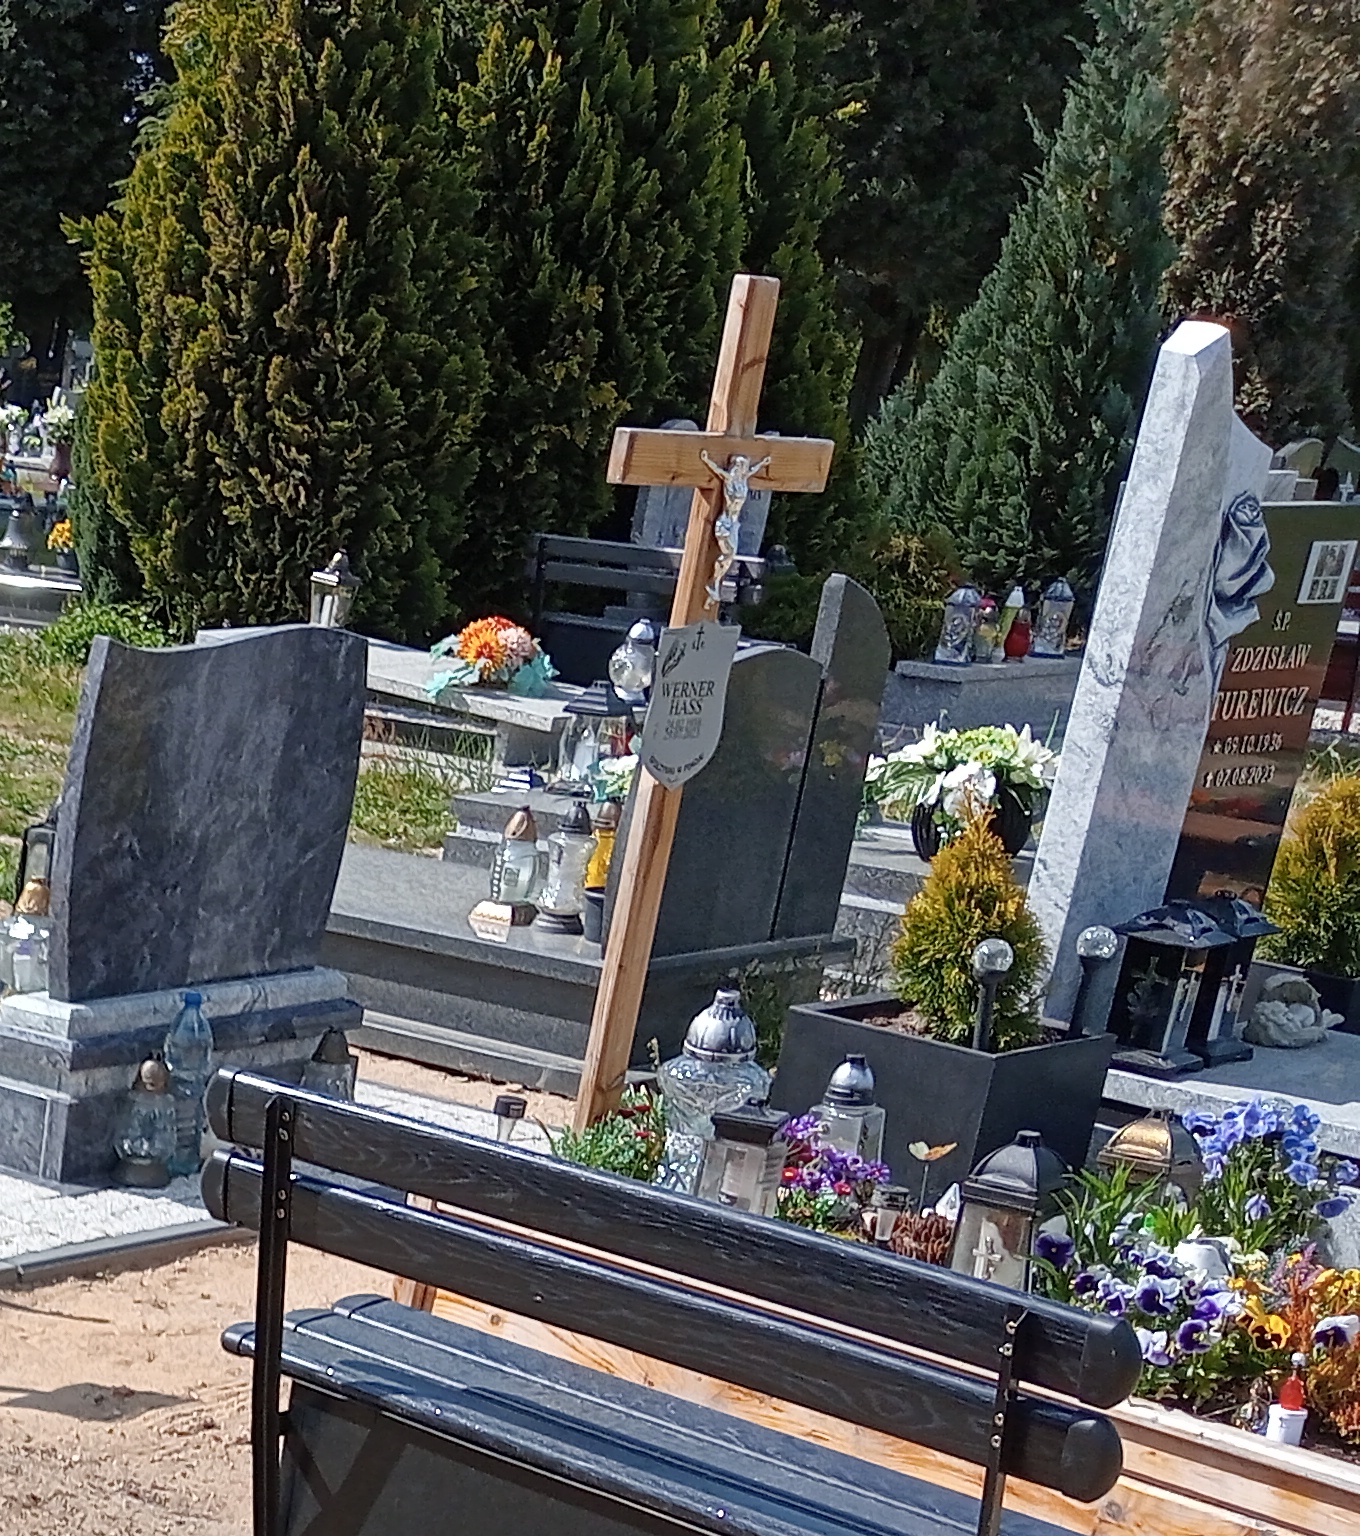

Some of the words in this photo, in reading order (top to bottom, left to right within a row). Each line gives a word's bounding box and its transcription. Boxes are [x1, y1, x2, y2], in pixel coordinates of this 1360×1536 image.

[1231, 644, 1312, 673] ZDZISŁAW
[661, 680, 715, 698] WERNER
[668, 699, 703, 715] HASS
